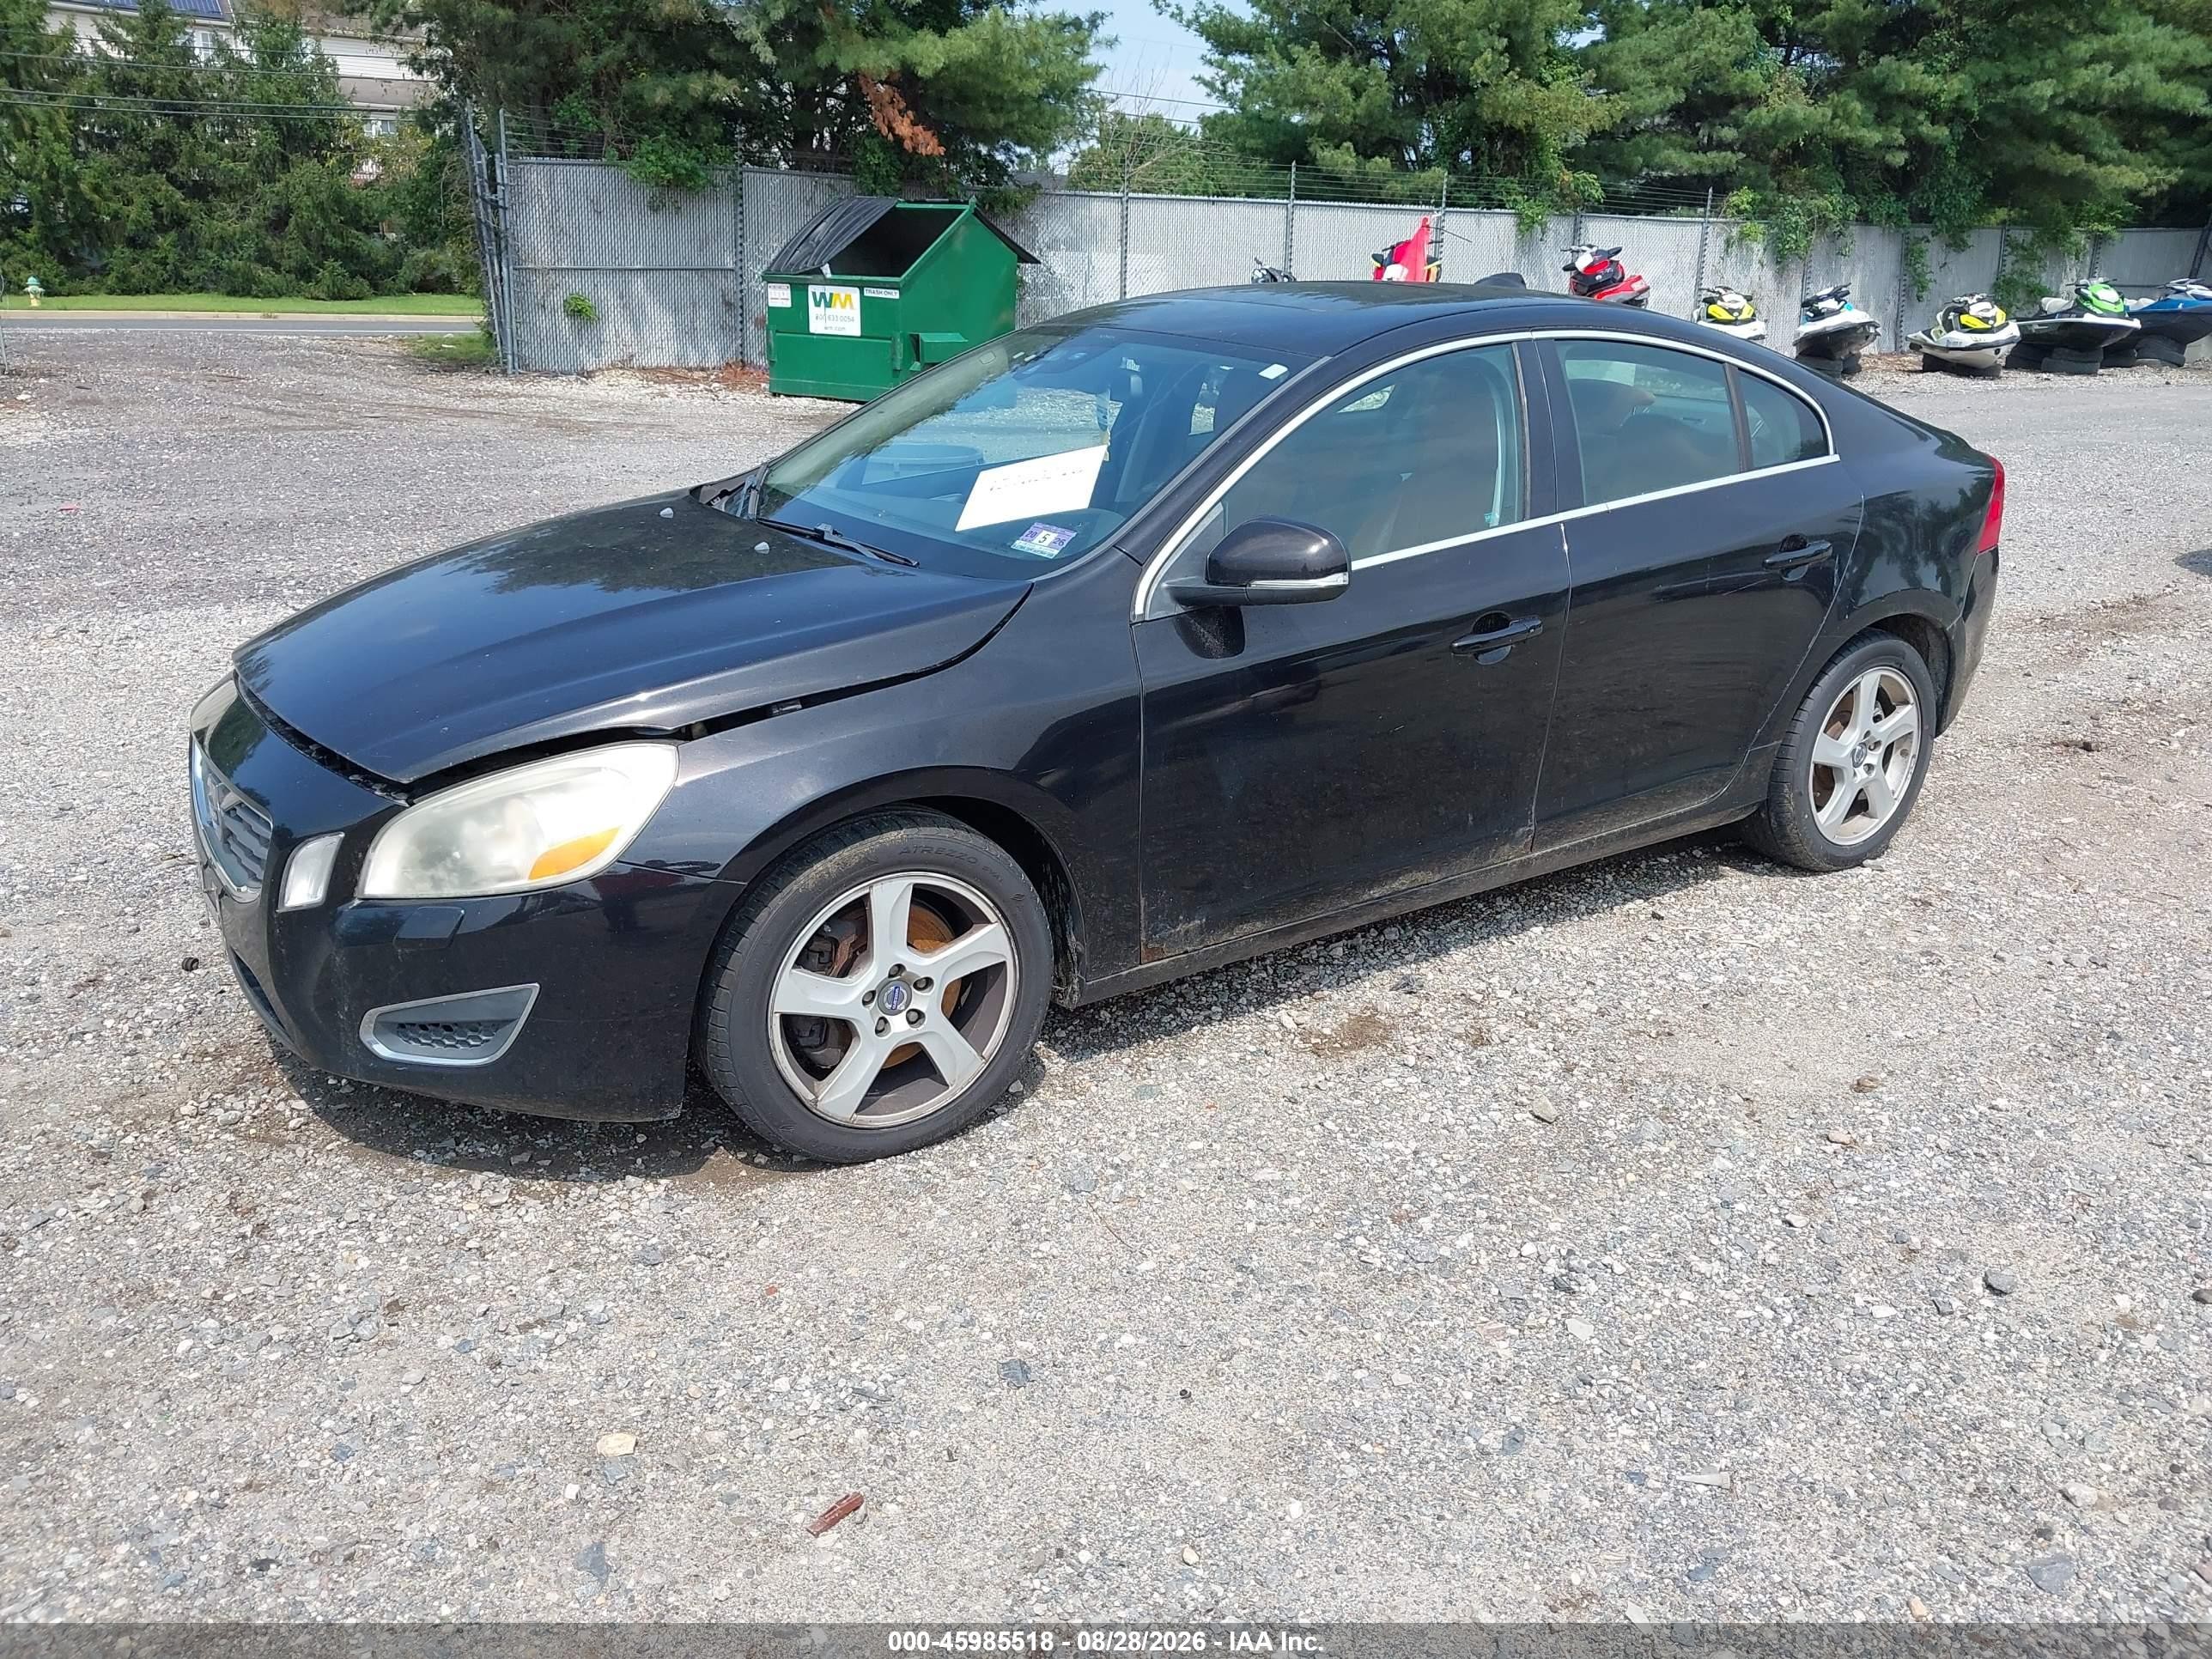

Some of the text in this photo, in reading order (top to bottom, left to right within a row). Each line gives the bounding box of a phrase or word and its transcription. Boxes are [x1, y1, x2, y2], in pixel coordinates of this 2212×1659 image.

[812, 291, 854, 310] WM
[1025, 530, 1066, 547] 20 5 26
[899, 844, 979, 865] ATREZZO
